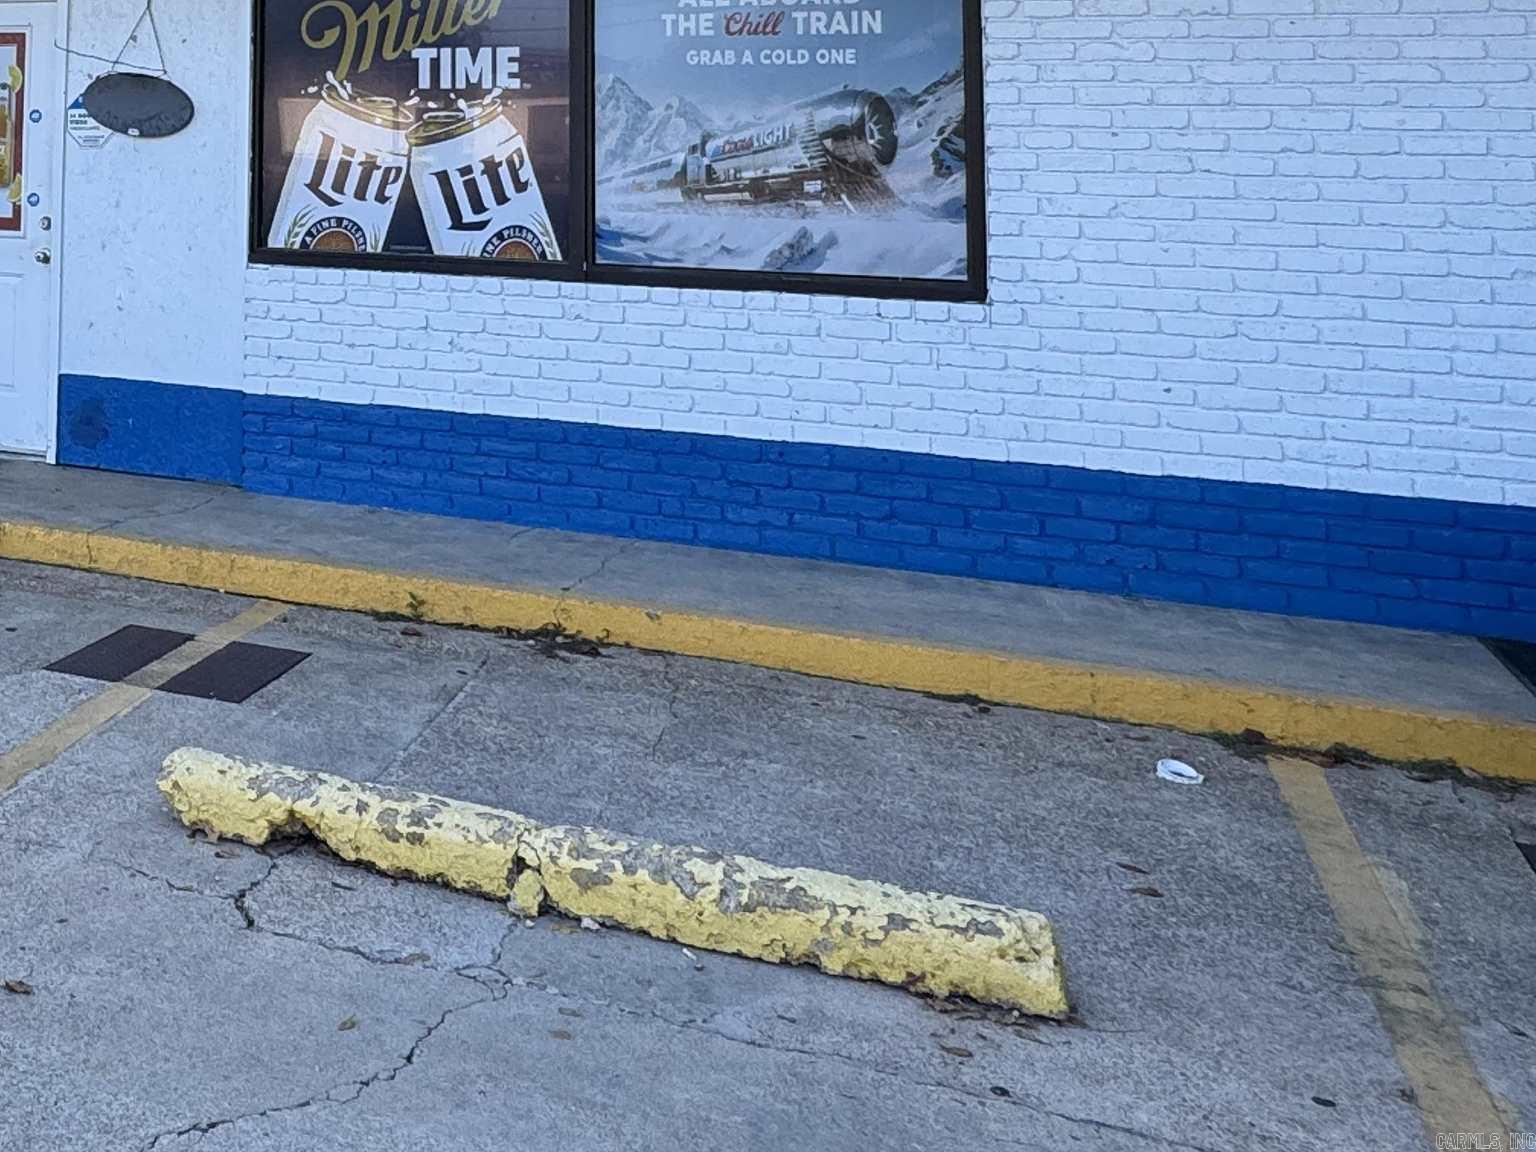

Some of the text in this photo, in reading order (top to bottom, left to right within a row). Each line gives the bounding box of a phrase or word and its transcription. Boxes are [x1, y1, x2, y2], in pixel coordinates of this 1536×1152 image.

[661, 10, 882, 37] THE Chill TRAIN
[411, 46, 521, 89] TIME
[686, 49, 857, 65] GRAB A COLD ONE
[752, 122, 794, 148] LIGHT
[304, 130, 403, 207] Lite
[429, 146, 529, 231] Lite
[304, 236, 313, 245] A
[310, 218, 338, 236] FINE
